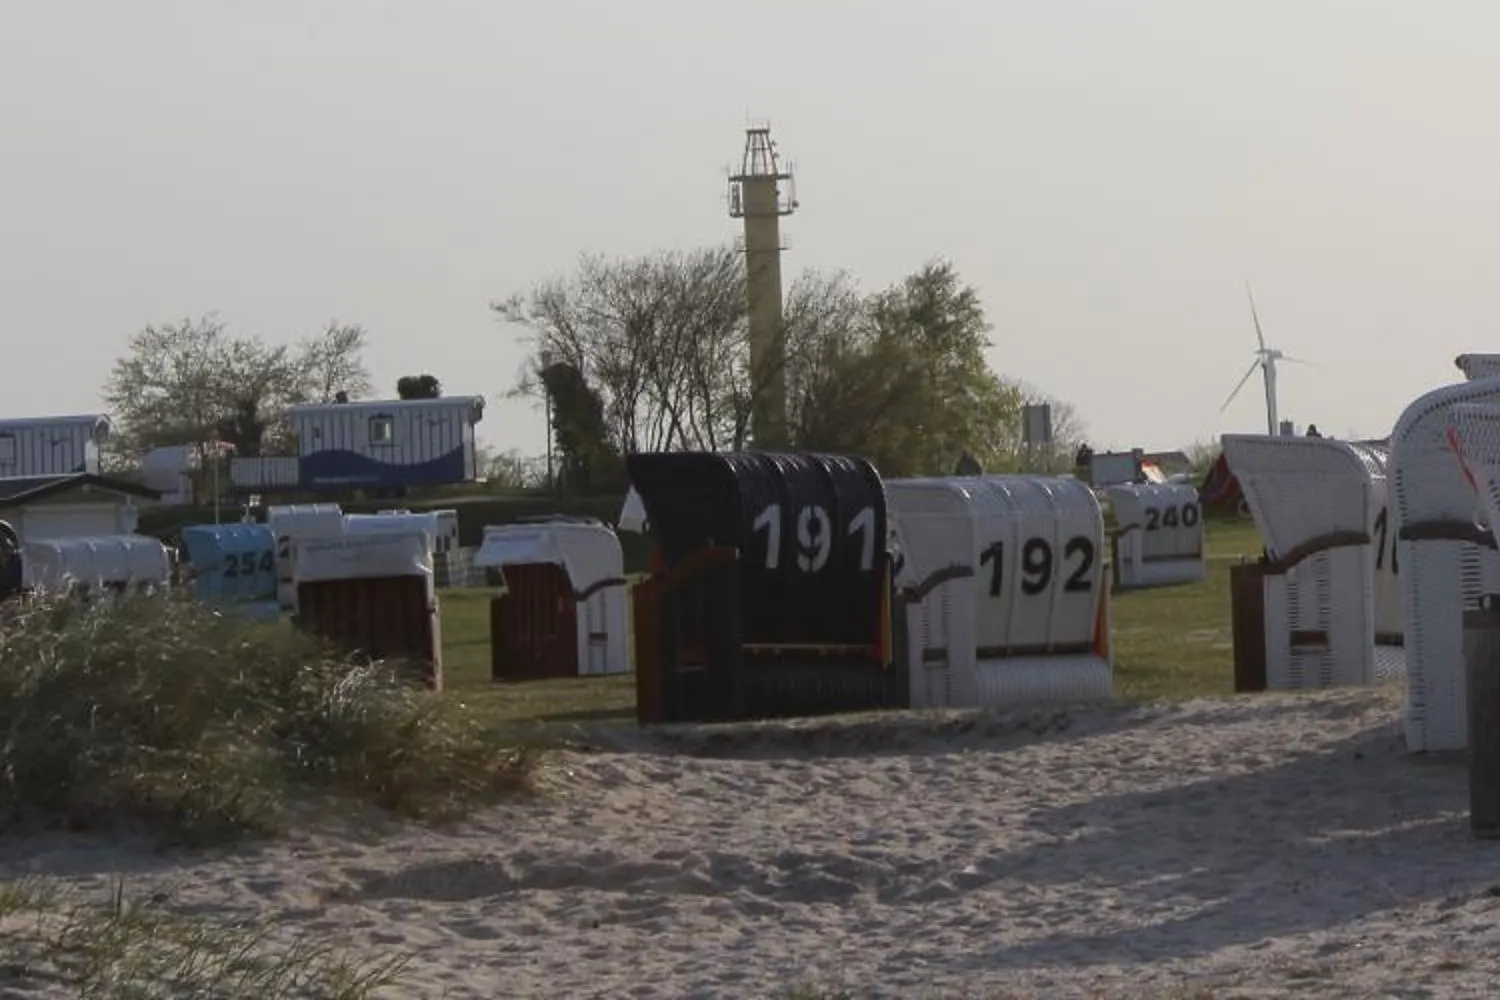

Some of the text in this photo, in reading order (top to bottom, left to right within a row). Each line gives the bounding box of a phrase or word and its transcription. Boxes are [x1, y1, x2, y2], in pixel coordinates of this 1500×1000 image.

[753, 504, 875, 572] 191
[1145, 503, 1198, 530] 240
[224, 552, 273, 577] 254
[979, 536, 1095, 597] 192
